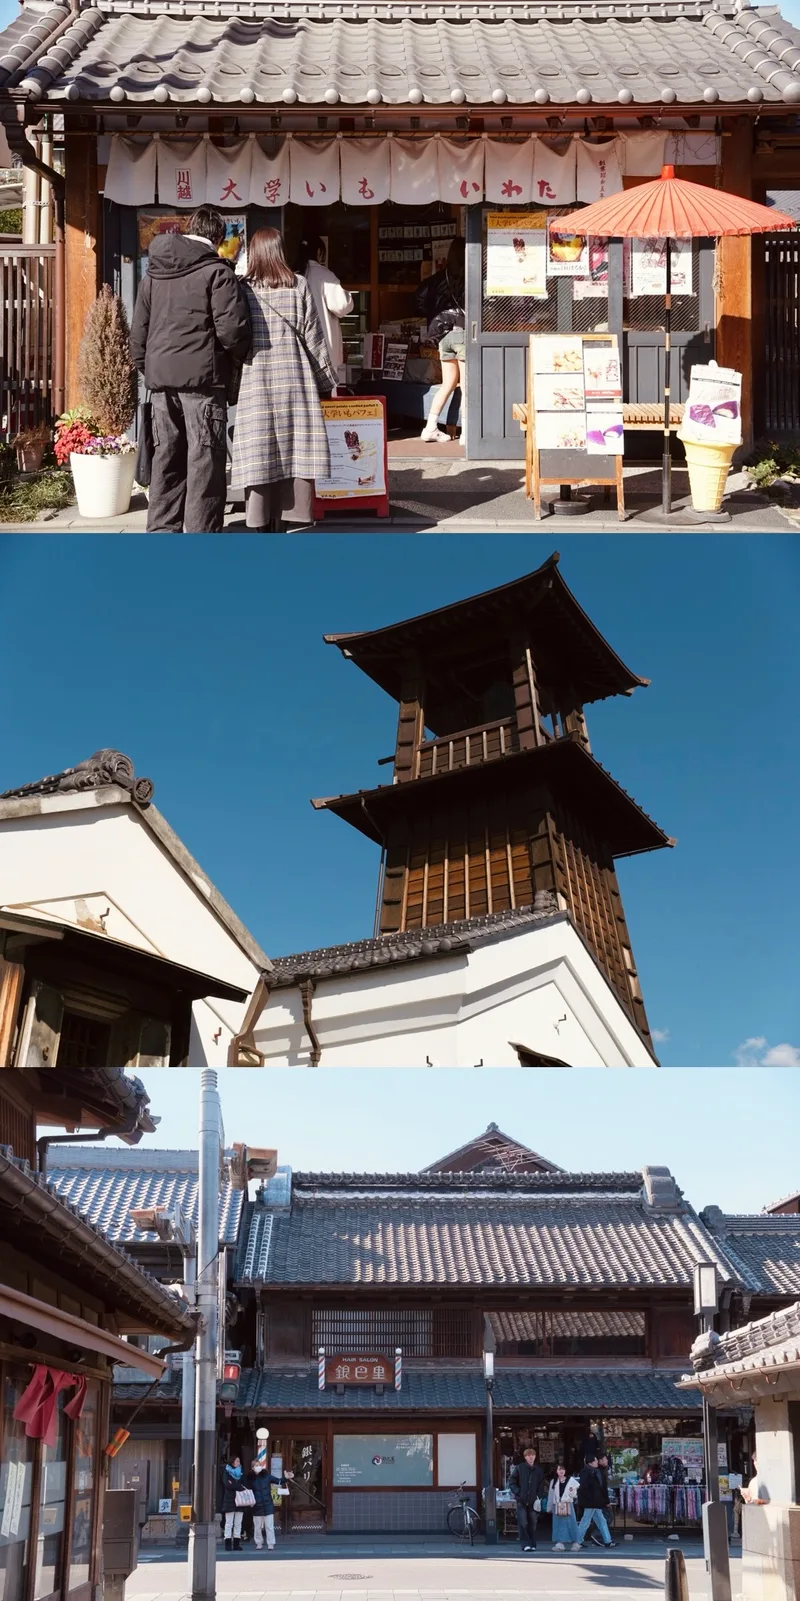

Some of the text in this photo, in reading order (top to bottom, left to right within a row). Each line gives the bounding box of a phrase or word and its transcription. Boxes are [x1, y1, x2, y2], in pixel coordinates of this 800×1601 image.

[176, 170, 192, 200] 川越
[219, 178, 557, 203] 大学いも いわた
